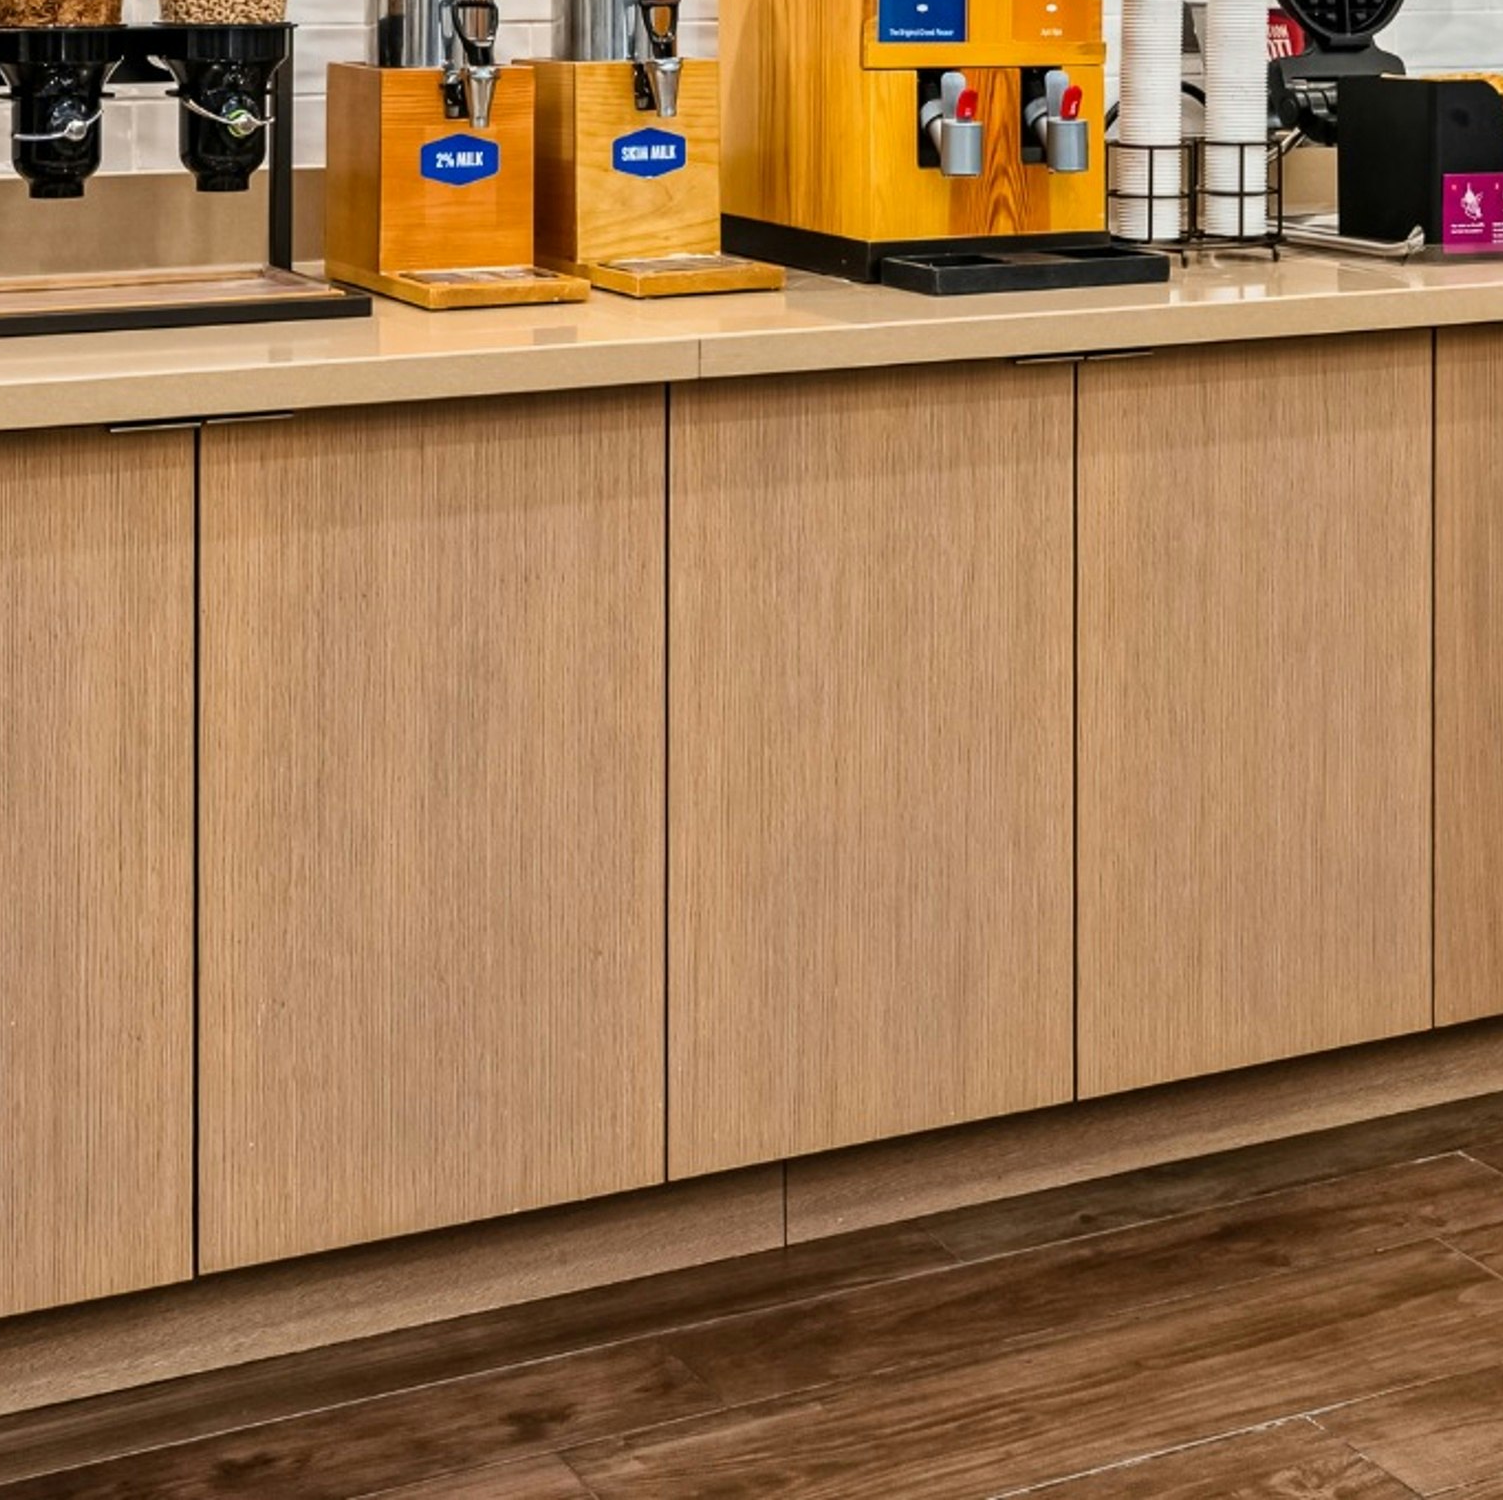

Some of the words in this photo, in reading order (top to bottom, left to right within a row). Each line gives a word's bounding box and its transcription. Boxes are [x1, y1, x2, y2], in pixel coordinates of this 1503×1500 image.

[436, 152, 455, 168] 2%
[456, 151, 484, 168] MILK
[650, 144, 677, 160] MILK
